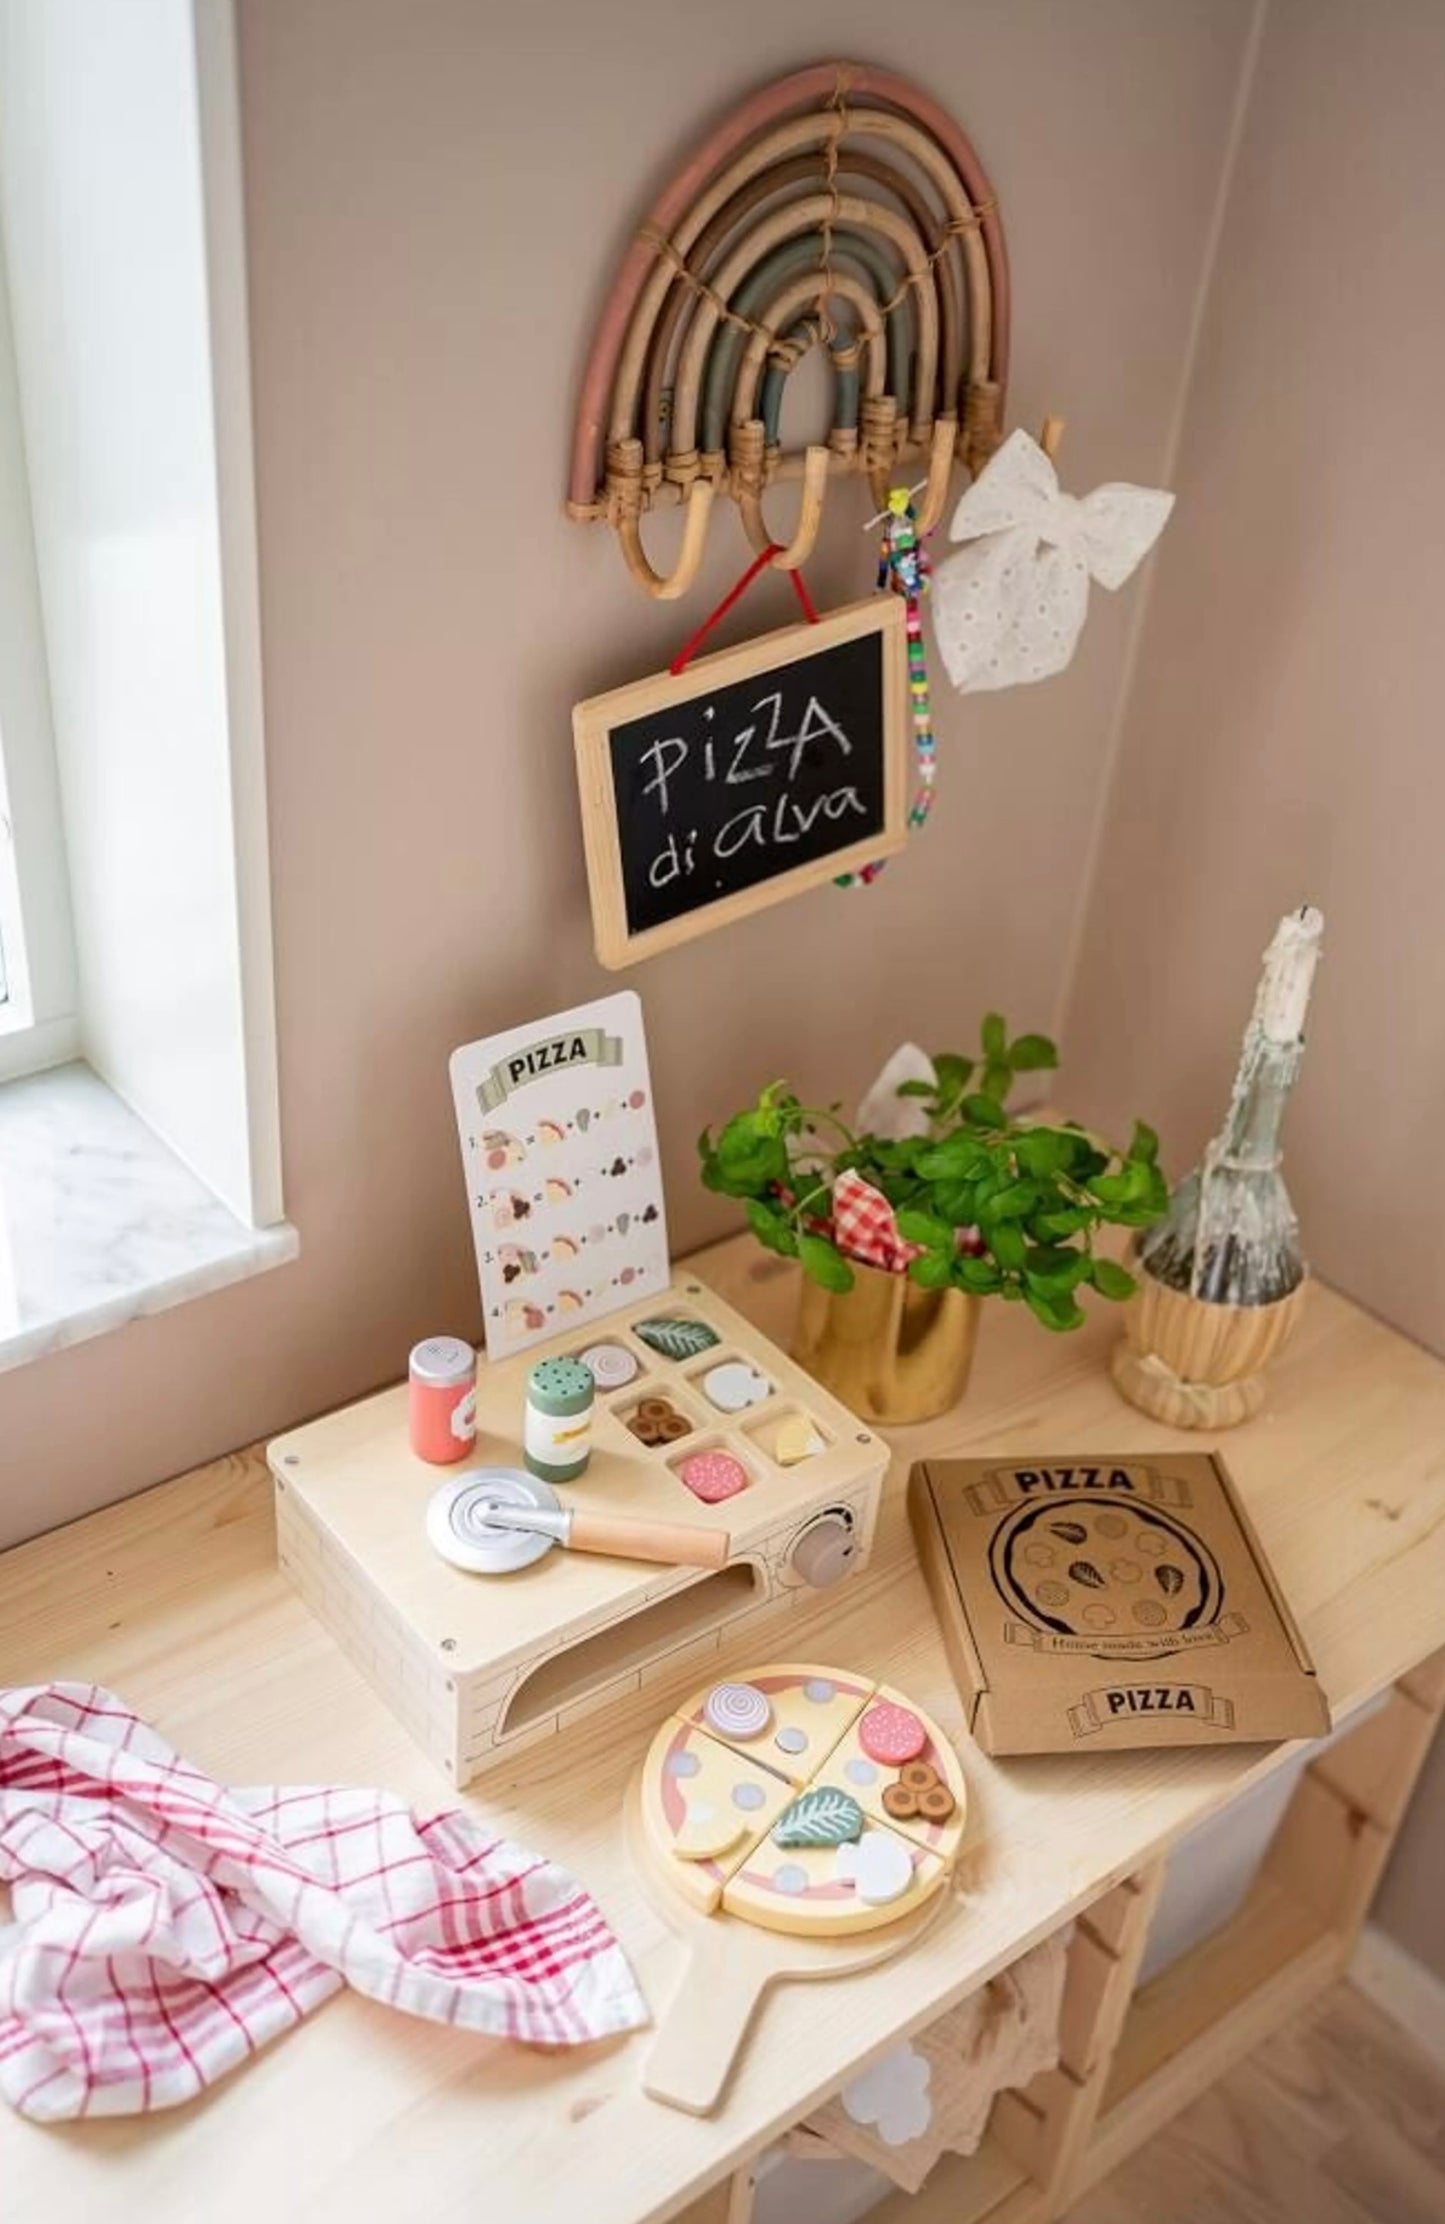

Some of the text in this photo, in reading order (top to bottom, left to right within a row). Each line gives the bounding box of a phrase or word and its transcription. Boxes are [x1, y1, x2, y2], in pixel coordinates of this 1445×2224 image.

[649, 829, 698, 888] di
[508, 1036, 587, 1084] PIZZA
[1014, 1467, 1135, 1494] PIZZA
[1106, 1689, 1195, 1715] PIZZA
